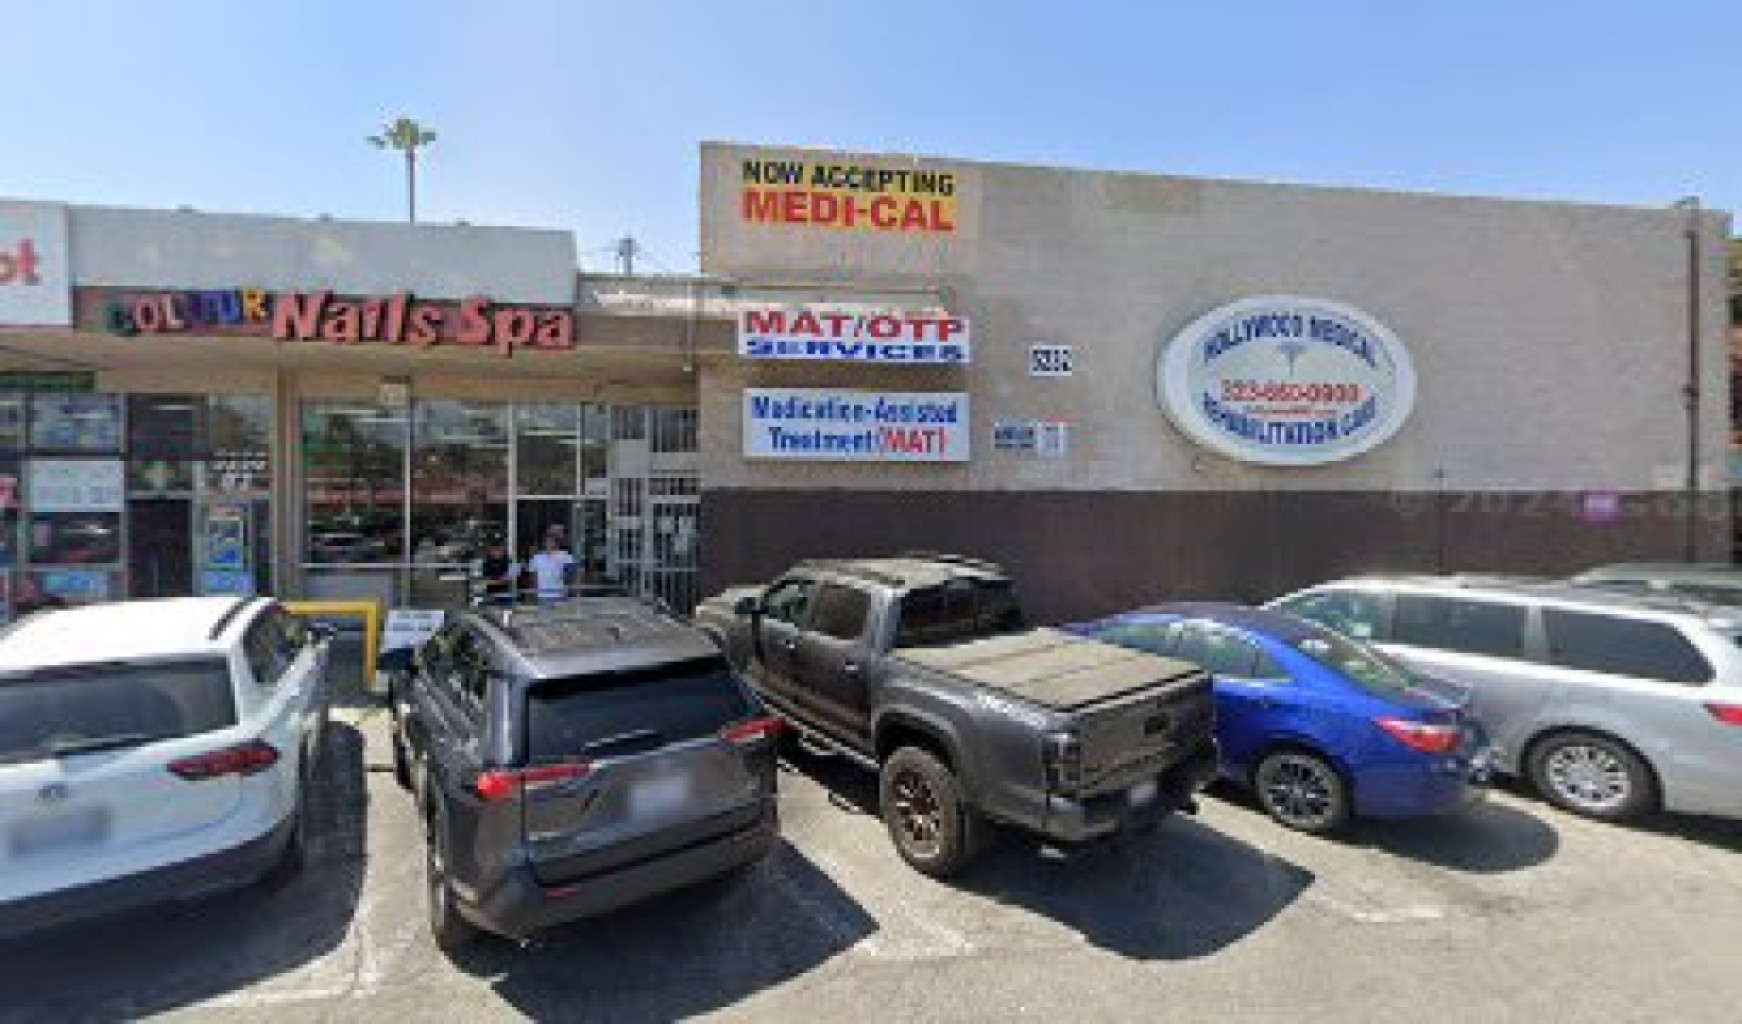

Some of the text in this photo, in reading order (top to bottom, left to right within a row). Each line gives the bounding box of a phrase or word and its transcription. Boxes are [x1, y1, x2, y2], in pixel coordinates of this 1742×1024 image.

[742, 160, 954, 196] NOW ACCEPTING
[742, 187, 954, 232] MEDI-CAL
[273, 289, 443, 347] Nails
[454, 298, 573, 358] Spa
[745, 309, 966, 342] MAT/OTP
[1203, 312, 1378, 368] HOLLYWOOD MEDICAL
[745, 340, 966, 360] SERVICES
[751, 396, 957, 424] Medication-Assisted
[1203, 391, 1337, 445] REHABILITATION
[768, 427, 949, 457] Treatment (MAT)
